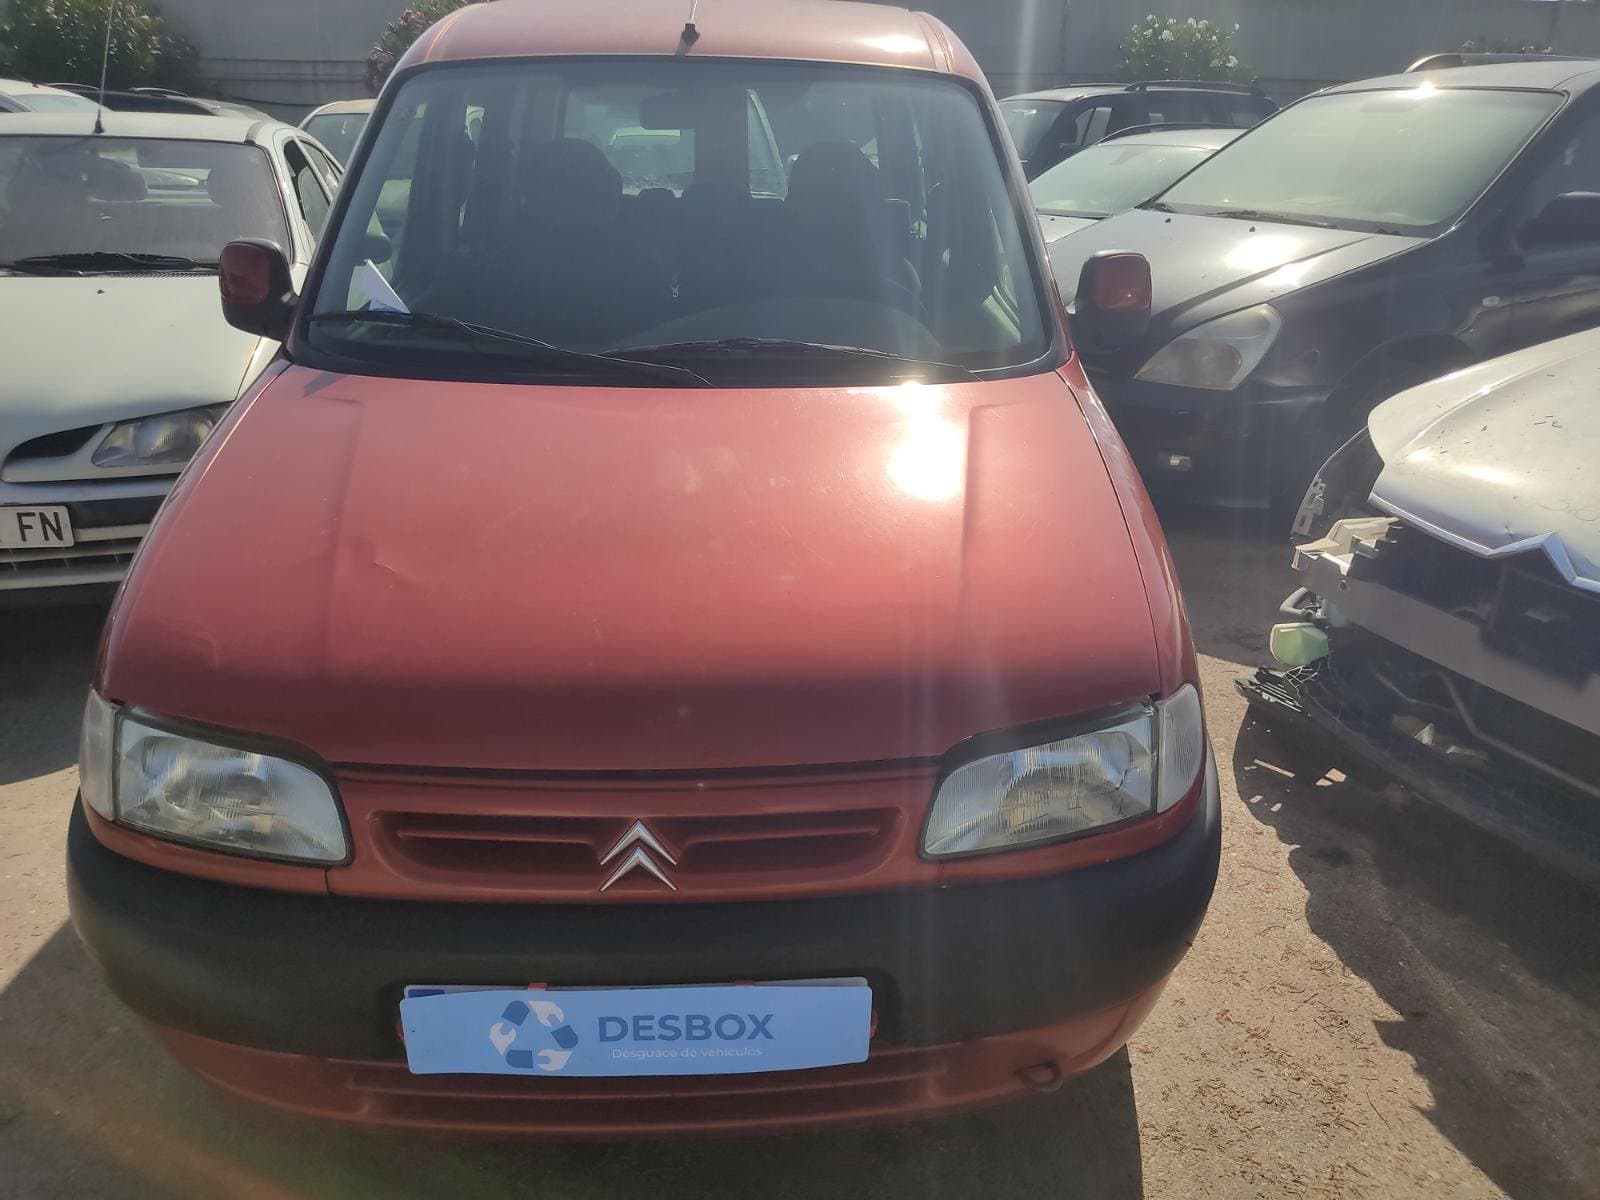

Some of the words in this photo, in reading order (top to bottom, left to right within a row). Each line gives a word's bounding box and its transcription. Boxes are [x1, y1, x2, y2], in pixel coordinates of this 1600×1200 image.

[16, 511, 64, 542] FN
[598, 1013, 775, 1042] DESBOX
[612, 1047, 678, 1060] Desguace
[680, 1047, 698, 1057] de
